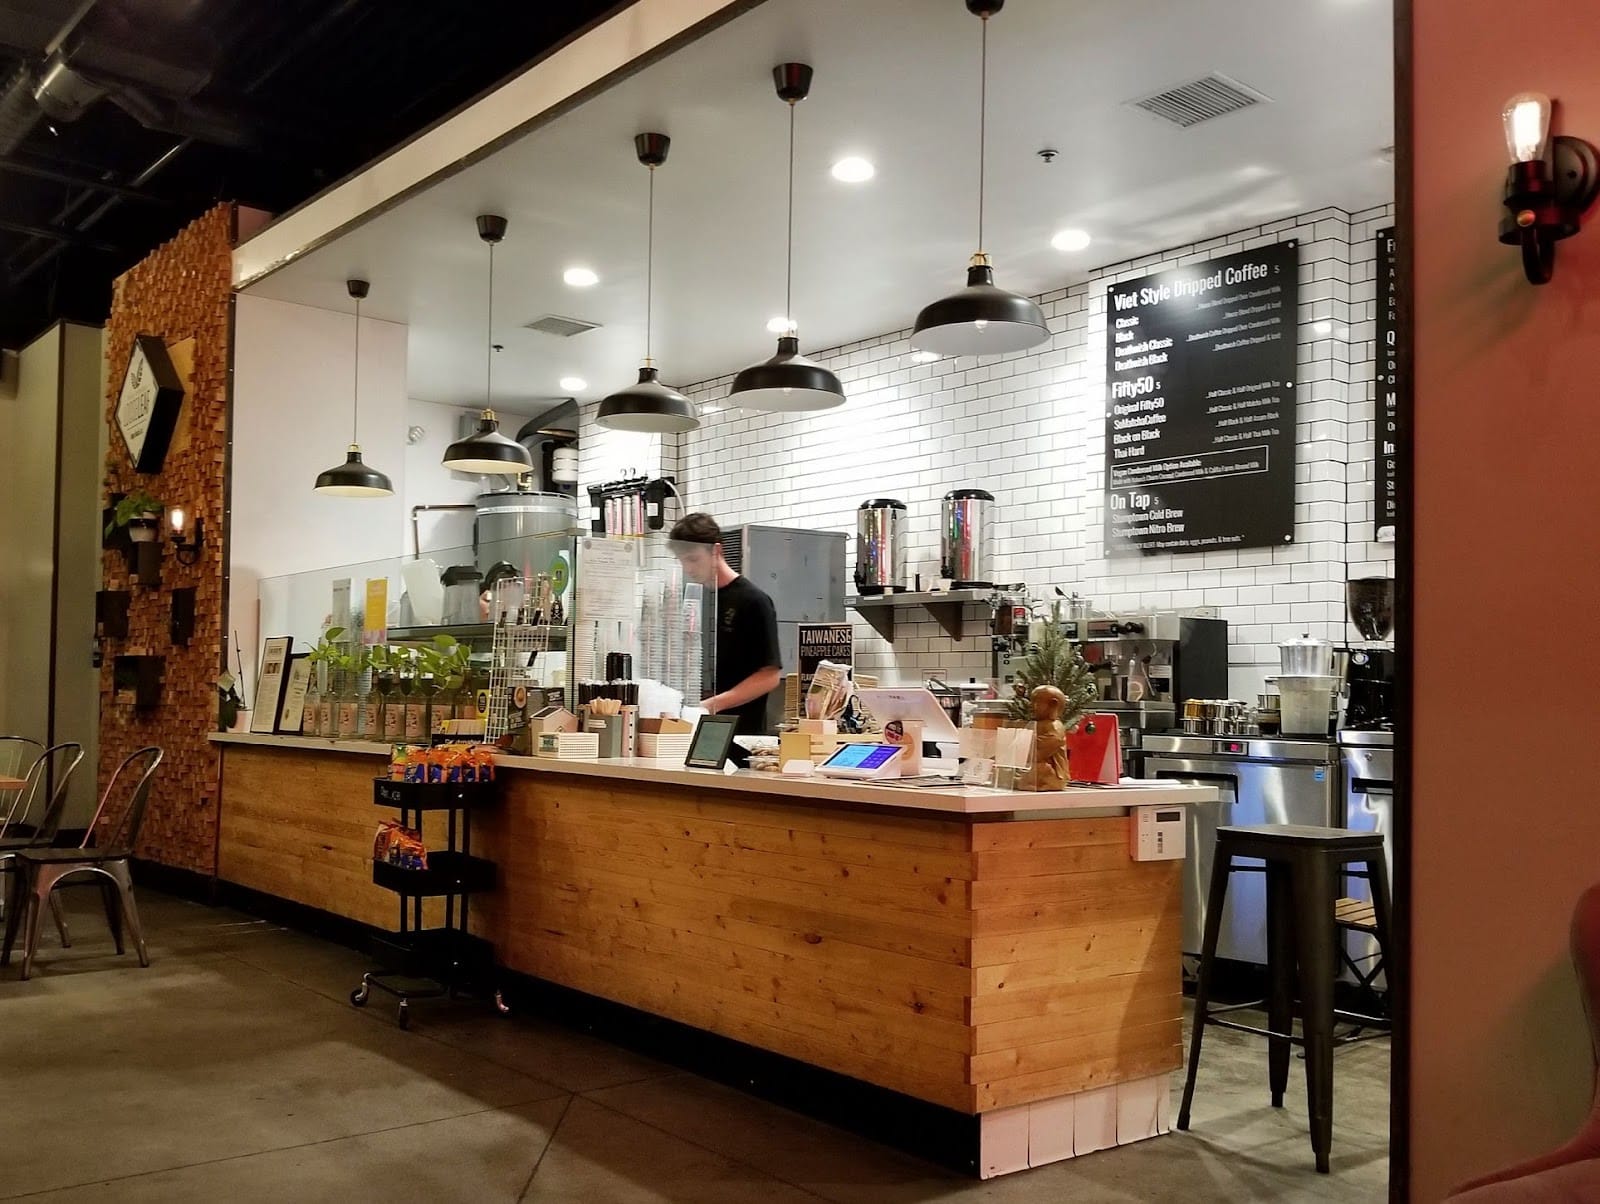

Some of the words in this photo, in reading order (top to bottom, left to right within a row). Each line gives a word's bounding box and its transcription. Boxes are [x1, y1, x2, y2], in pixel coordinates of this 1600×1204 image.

[1114, 292, 1138, 311] Viet
[1140, 284, 1170, 305] Style
[1174, 270, 1222, 296] Dripped
[1225, 264, 1268, 285] Coffee
[1116, 316, 1140, 328] Classic
[1148, 338, 1173, 350] Classic
[1149, 352, 1168, 365] Black
[1112, 376, 1154, 398] Fifty50
[1114, 402, 1139, 415] Original
[1140, 397, 1164, 410] Fifty50
[1114, 433, 1132, 444] Black
[1142, 428, 1160, 440] Black
[1114, 448, 1128, 458] Thai
[1128, 445, 1144, 456] Hard
[1110, 494, 1126, 510] On
[1129, 492, 1150, 510] Tap
[1149, 510, 1164, 520] Cold
[1165, 508, 1184, 519] Brew
[1149, 524, 1166, 534] Nitro
[1166, 522, 1184, 532] Brew
[801, 630, 852, 644] TAIWANESE
[800, 646, 832, 656] PINEAPPLE
[832, 646, 850, 656] CAKES
